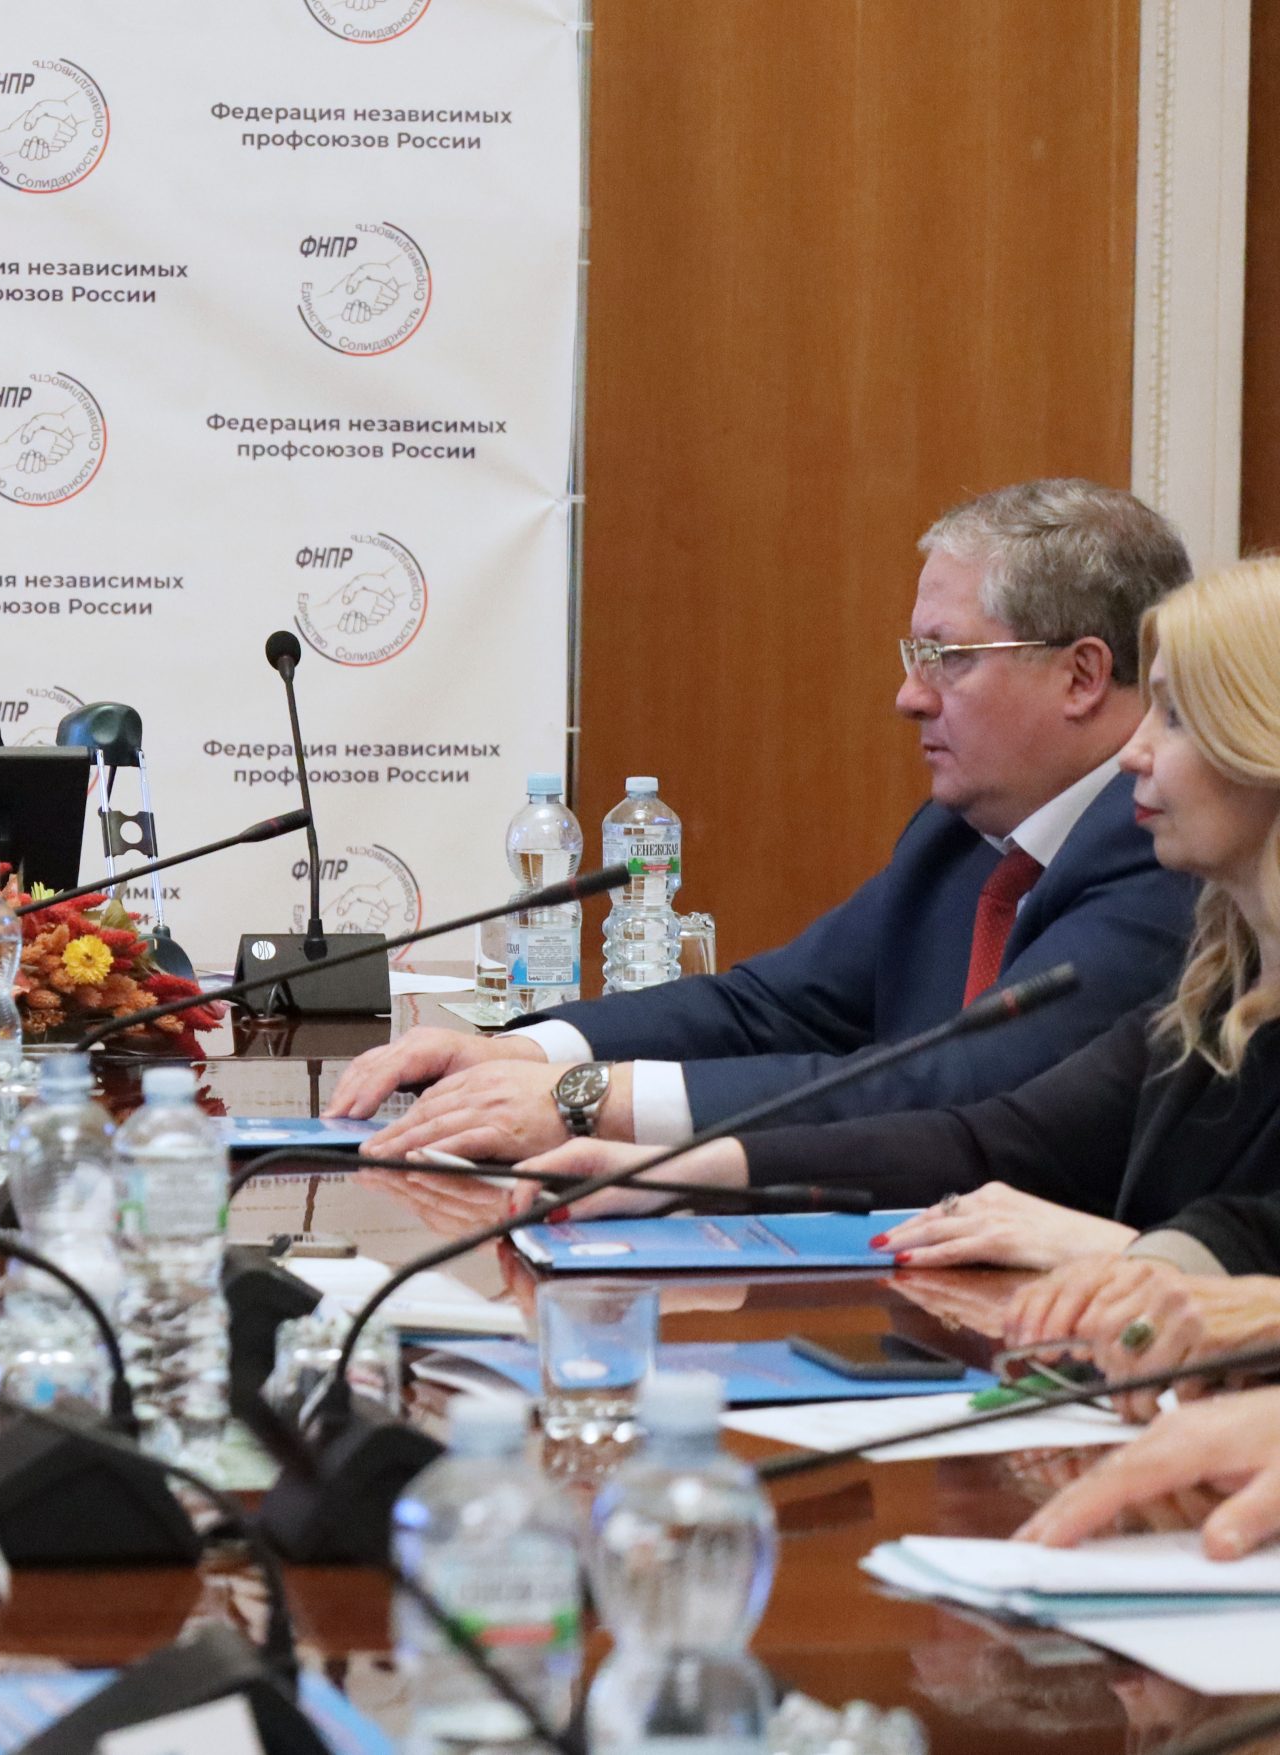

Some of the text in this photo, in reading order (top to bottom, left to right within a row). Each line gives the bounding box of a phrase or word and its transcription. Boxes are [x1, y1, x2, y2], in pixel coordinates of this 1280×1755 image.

[313, 0, 421, 38] ство Солидарност
[32, 61, 105, 137] Справедливость
[211, 103, 511, 124] Федерация независимых
[242, 130, 480, 150] профсоюзов России
[17, 143, 99, 187] Солидарность
[300, 235, 357, 257] ФНПР
[28, 263, 187, 278] независимых
[72, 286, 155, 302] России
[303, 225, 428, 351] Единство Солидарность Справедливость
[30, 375, 103, 451] Справедливость
[207, 414, 506, 434] Федерация независимых
[238, 441, 475, 461] профсоюзов России
[15, 457, 97, 501] Солидарность
[296, 547, 353, 568] ФНПР
[25, 575, 183, 589] независимых
[69, 599, 152, 614] России
[300, 535, 425, 661] Единство Солидарность Справедливость
[346, 744, 499, 757] независимых
[387, 767, 468, 782] России
[630, 844, 679, 856] СЕНЕЖСКАЯ
[292, 858, 348, 881] ФПР
